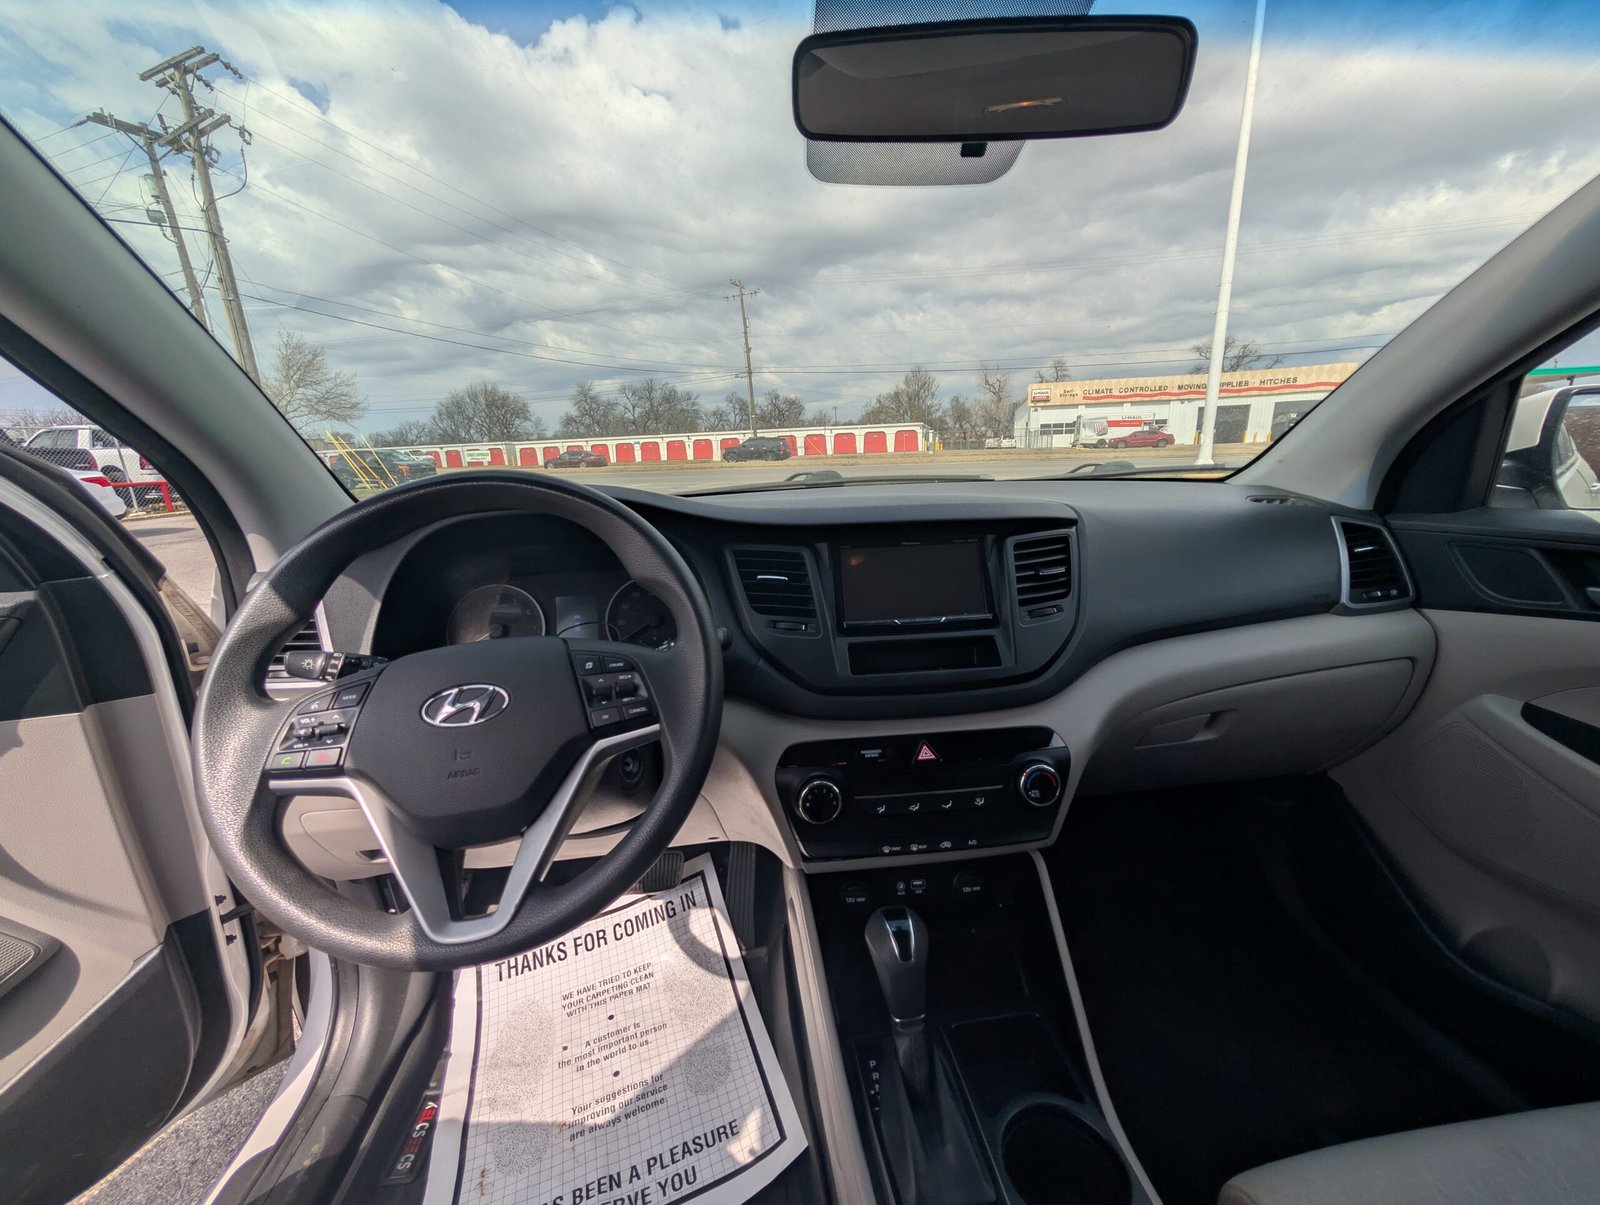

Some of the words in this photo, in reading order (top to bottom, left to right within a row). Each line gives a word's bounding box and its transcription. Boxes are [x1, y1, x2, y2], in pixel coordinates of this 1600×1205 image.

[1082, 387, 1113, 395] CLIMATE
[1118, 384, 1169, 394] CONTROLLED
[1177, 382, 1207, 391] MOVING
[1259, 376, 1298, 386] HITCHES
[495, 941, 568, 982] THANKS
[573, 929, 608, 956] FOR
[613, 900, 677, 941] COMING
[680, 890, 697, 912] IN
[561, 997, 584, 1011] YOUR
[586, 980, 628, 1003] CARPETING
[630, 971, 654, 985] CLEAN
[562, 992, 575, 1001] WE
[576, 983, 597, 996] HAVE
[598, 975, 620, 988] TRIED
[622, 969, 632, 979] TO
[633, 962, 652, 974] KEEP
[566, 1005, 587, 1018] WITH
[589, 998, 608, 1009] THIS
[609, 989, 634, 1002] PAPER
[635, 982, 652, 993] MAT
[558, 1058, 572, 1069] the
[574, 1048, 596, 1063] most
[597, 1032, 639, 1053] important
[639, 1022, 668, 1039] person
[576, 1064, 585, 1072] in
[586, 1057, 601, 1068] the
[602, 1046, 627, 1061] world
[628, 1042, 637, 1051] to
[639, 1038, 653, 1048] us.
[584, 1040, 591, 1049] A
[593, 1026, 632, 1045] customer
[567, 1104, 616, 1129] improving
[618, 1098, 633, 1110] our
[635, 1083, 668, 1102] service
[571, 1101, 593, 1115] Your
[595, 1078, 649, 1106] suggestions
[651, 1073, 664, 1084] for
[569, 1129, 586, 1142] are
[588, 1115, 622, 1134] always
[624, 1097, 669, 1120] welcome.
[572, 1171, 622, 1205] BEEN
[628, 1164, 641, 1185] A
[646, 1119, 740, 1176] PLEASURE
[657, 1165, 698, 1198] YOU
